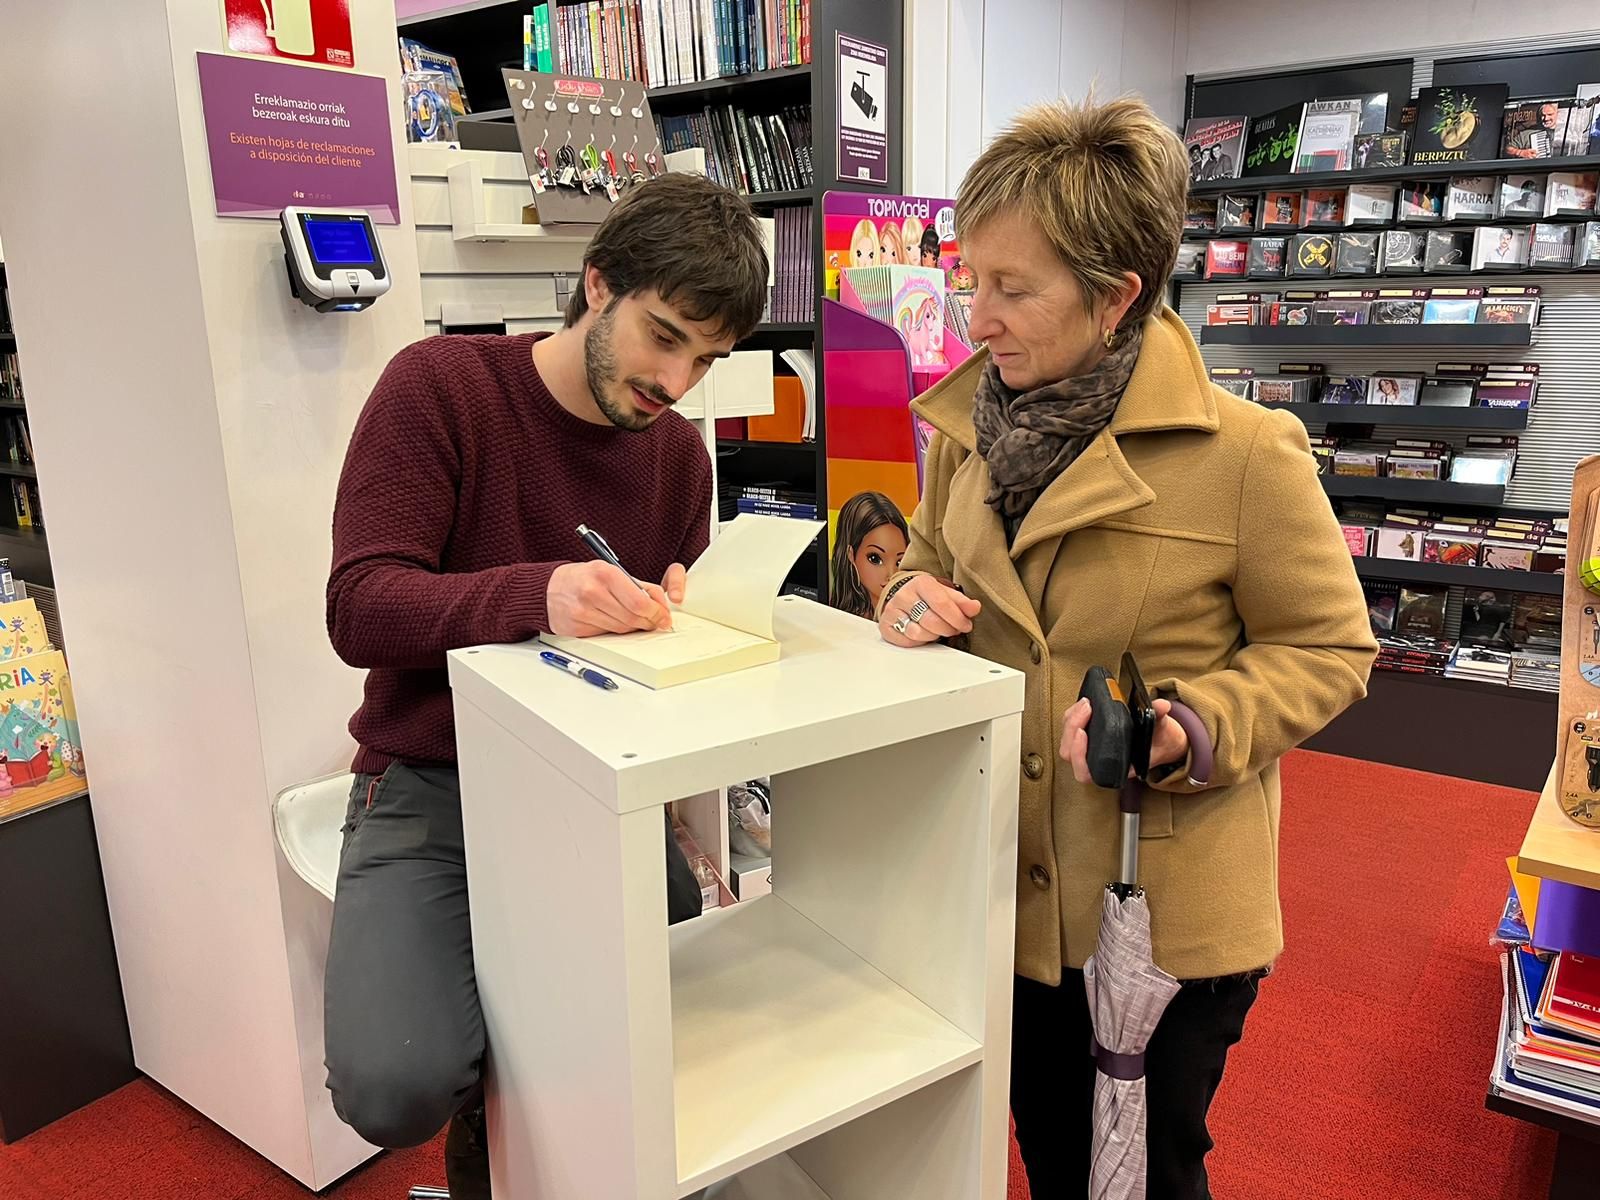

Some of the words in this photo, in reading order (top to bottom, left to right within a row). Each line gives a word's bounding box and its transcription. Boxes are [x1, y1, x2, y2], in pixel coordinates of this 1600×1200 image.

[254, 93, 317, 112] Erreklamazio
[318, 102, 346, 115] orriak
[252, 106, 298, 123] bezeroak
[299, 113, 330, 126] eskura
[331, 114, 350, 128] ditu
[230, 132, 266, 146] Existen
[268, 136, 295, 152] hojas
[297, 139, 309, 151] de
[311, 140, 375, 156] reclamaciones
[250, 150, 256, 158] a
[258, 149, 313, 165] disposición
[315, 153, 330, 165] del
[331, 155, 361, 168] cliente
[1414, 151, 1468, 161] BERPIZTU
